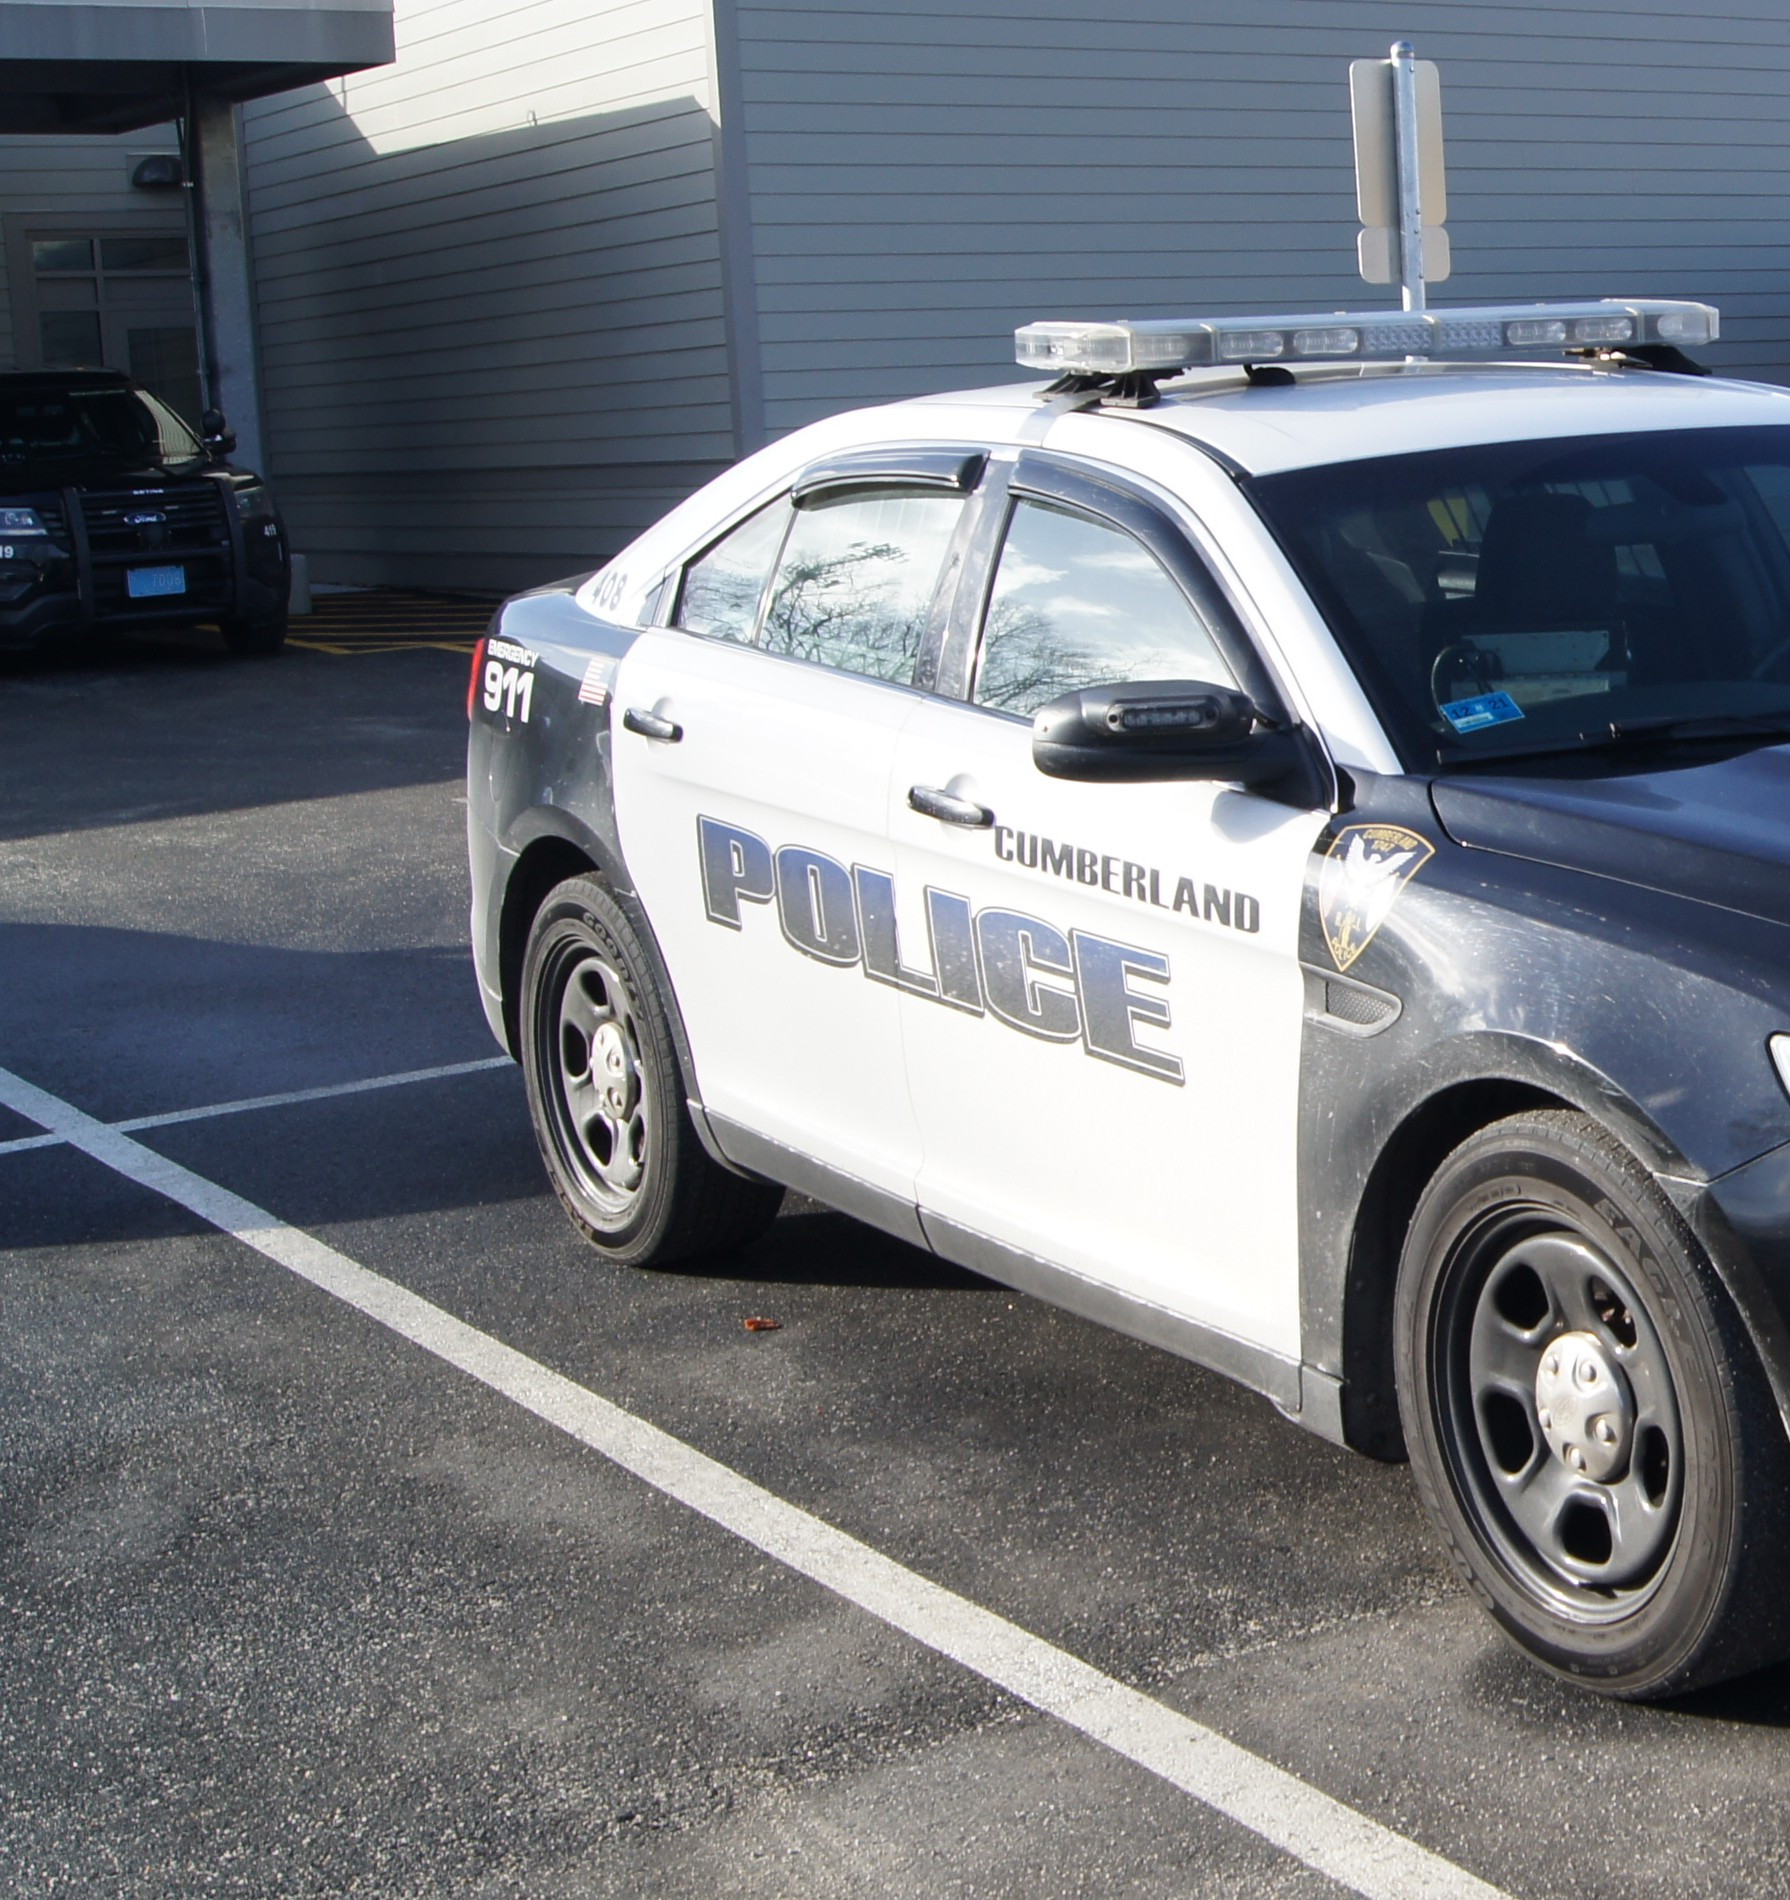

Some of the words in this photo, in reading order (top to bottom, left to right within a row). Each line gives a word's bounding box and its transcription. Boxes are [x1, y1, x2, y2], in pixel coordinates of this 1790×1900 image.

[591, 571, 628, 612] 408
[487, 638, 541, 668] EMERGENCY
[483, 660, 536, 724] 911
[994, 825, 1260, 934] CUMBERLAND
[696, 812, 1187, 1087] POLICE
